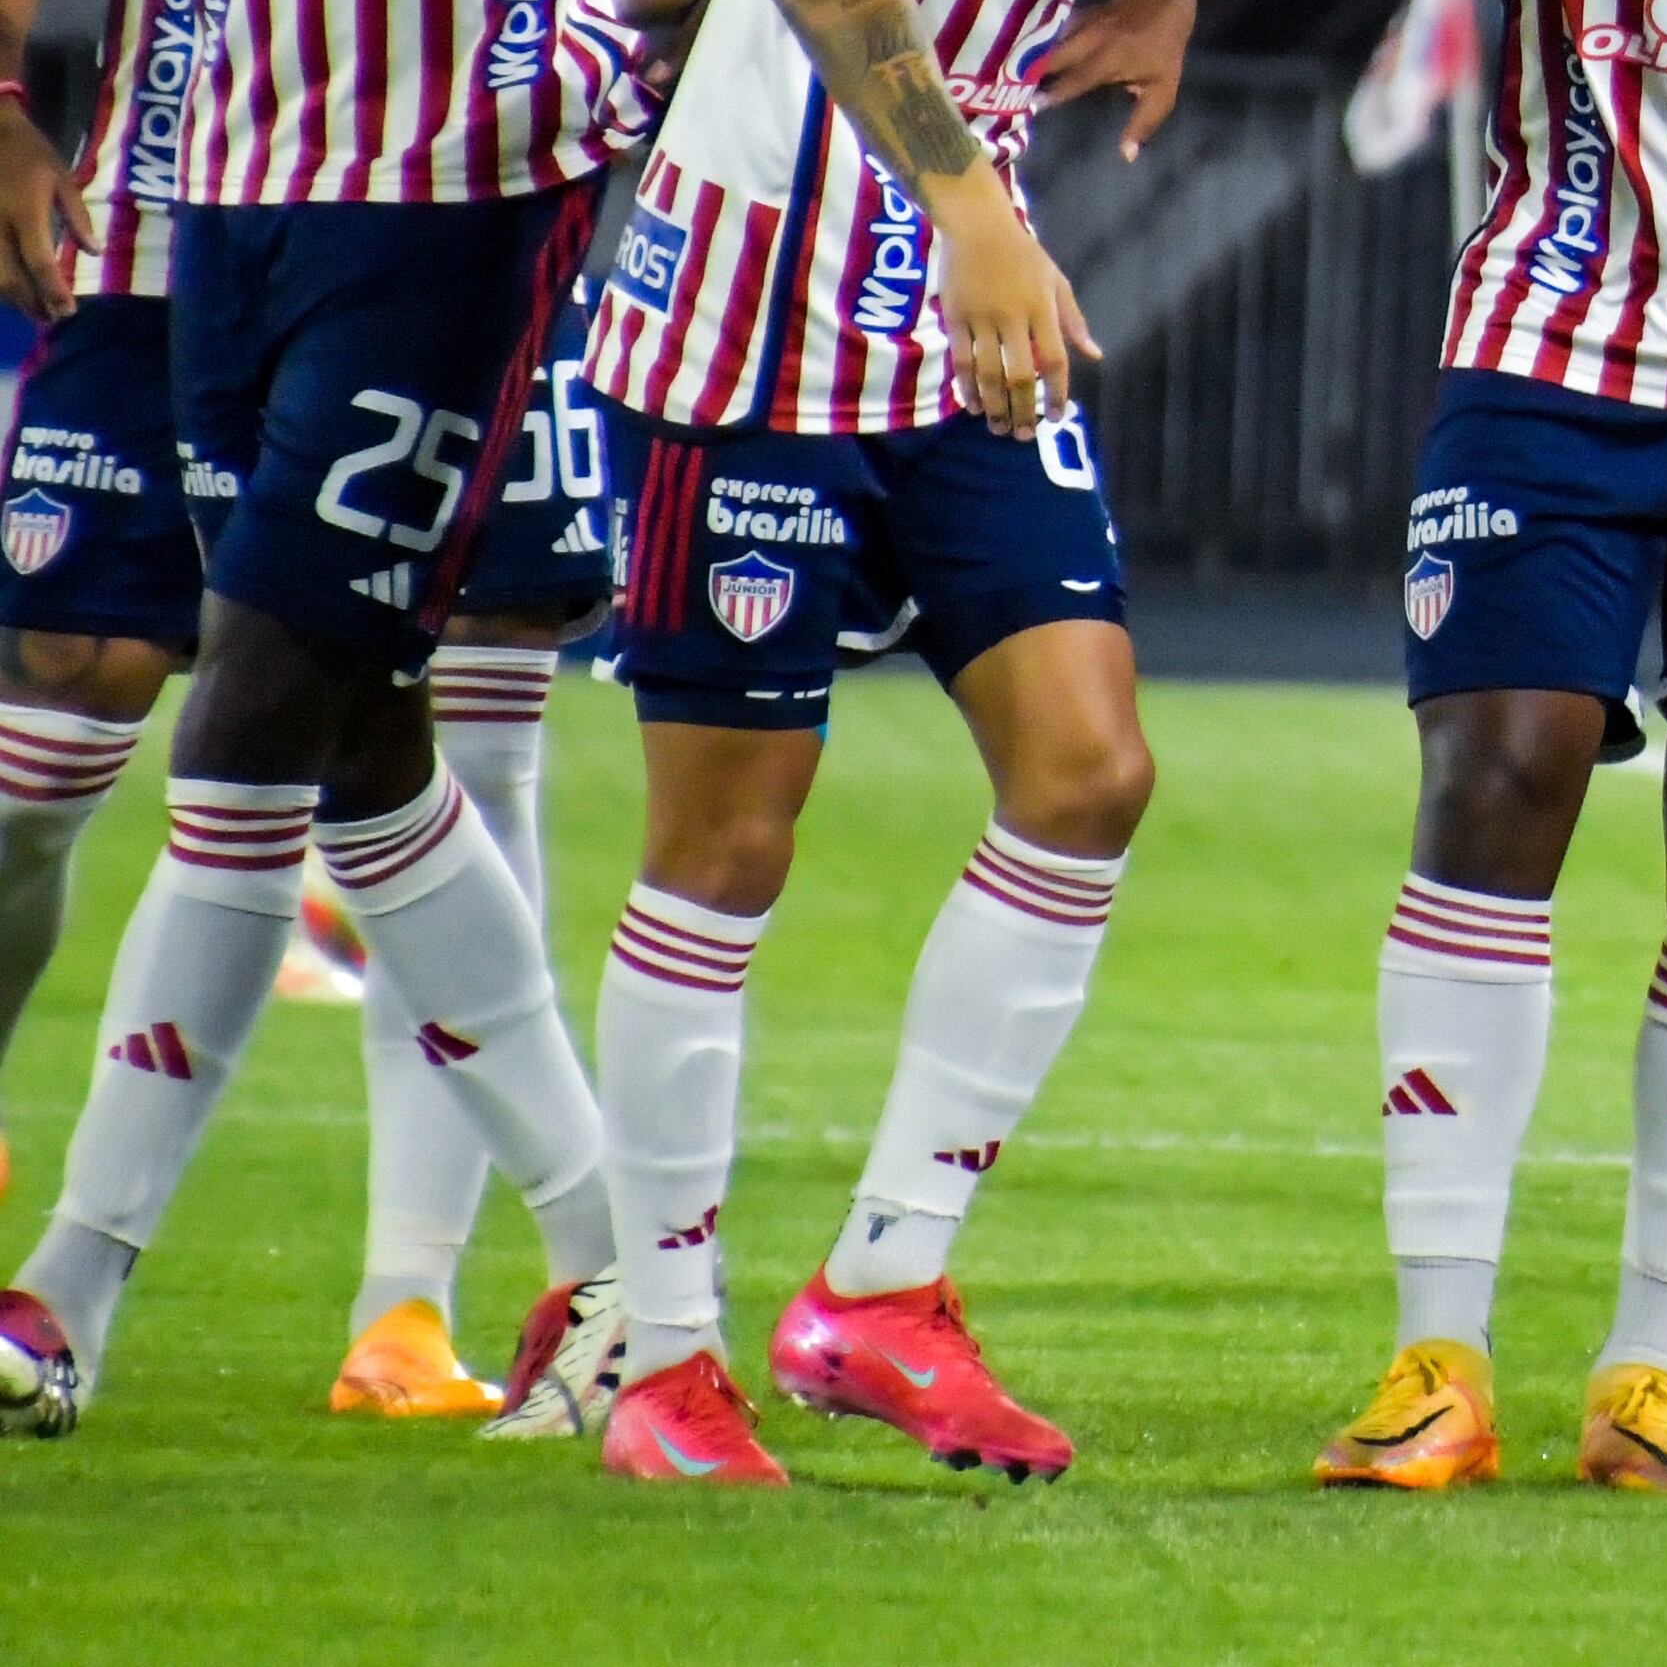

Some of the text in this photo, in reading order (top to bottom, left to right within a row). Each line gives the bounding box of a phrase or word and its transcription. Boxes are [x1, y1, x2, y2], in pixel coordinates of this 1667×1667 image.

[316, 389, 479, 552] 25
[711, 476, 817, 506] expreso
[706, 498, 847, 546] brasilia
[721, 580, 781, 597] JUNIOR
